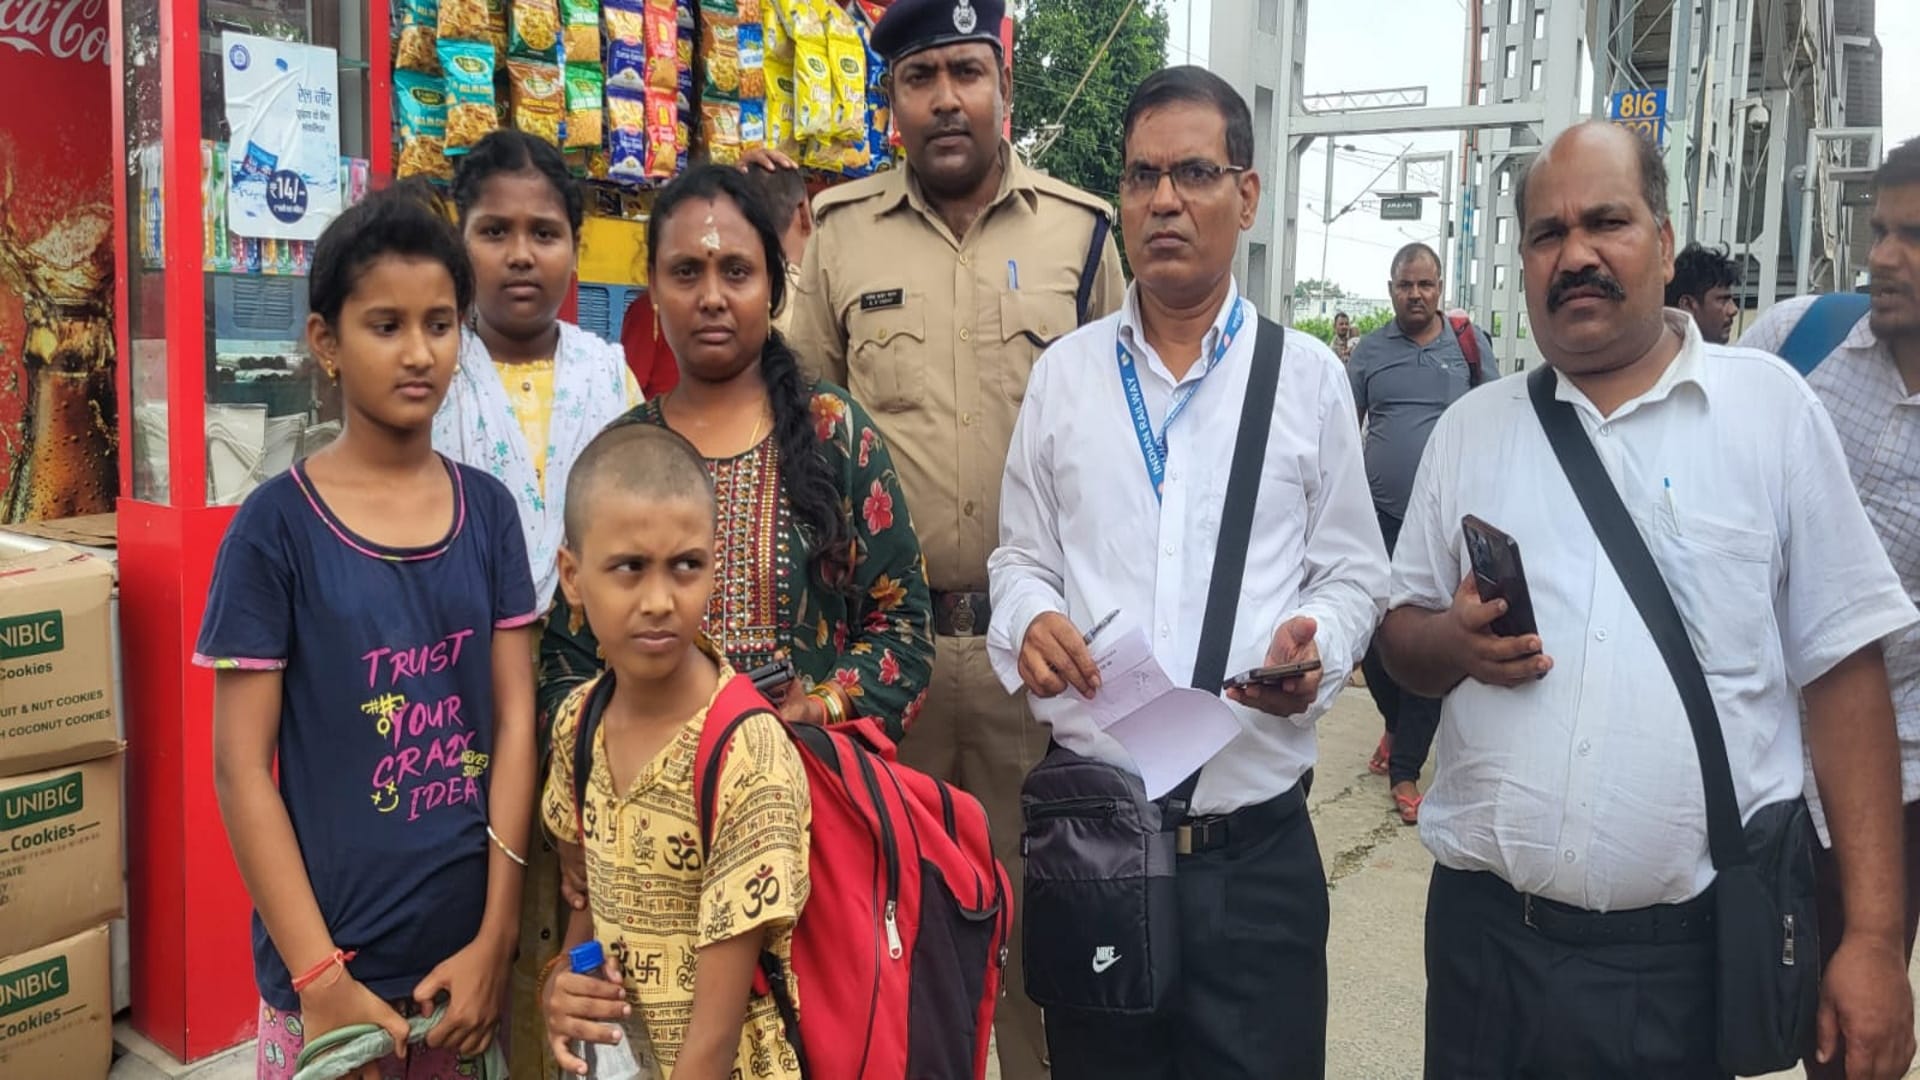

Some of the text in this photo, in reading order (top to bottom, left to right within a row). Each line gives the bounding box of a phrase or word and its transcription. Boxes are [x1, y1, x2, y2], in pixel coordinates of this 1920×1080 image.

[1620, 92, 1657, 118] 816
[1125, 376, 1149, 431] RAILWAY
[1141, 428, 1163, 475] INDIAN
[361, 628, 475, 689] TRUST
[21, 705, 28, 714] &
[31, 700, 53, 712] NUT
[56, 689, 104, 707] COOKIES
[9, 719, 63, 738] COCONUT
[65, 709, 111, 727] COOKIES
[388, 695, 464, 750] YOUR
[372, 731, 476, 789] CRAZY
[5, 782, 77, 819] UNIBIC
[407, 776, 479, 821] IDEA
[11, 824, 76, 852] Cookies
[1096, 946, 1115, 960] NIKE
